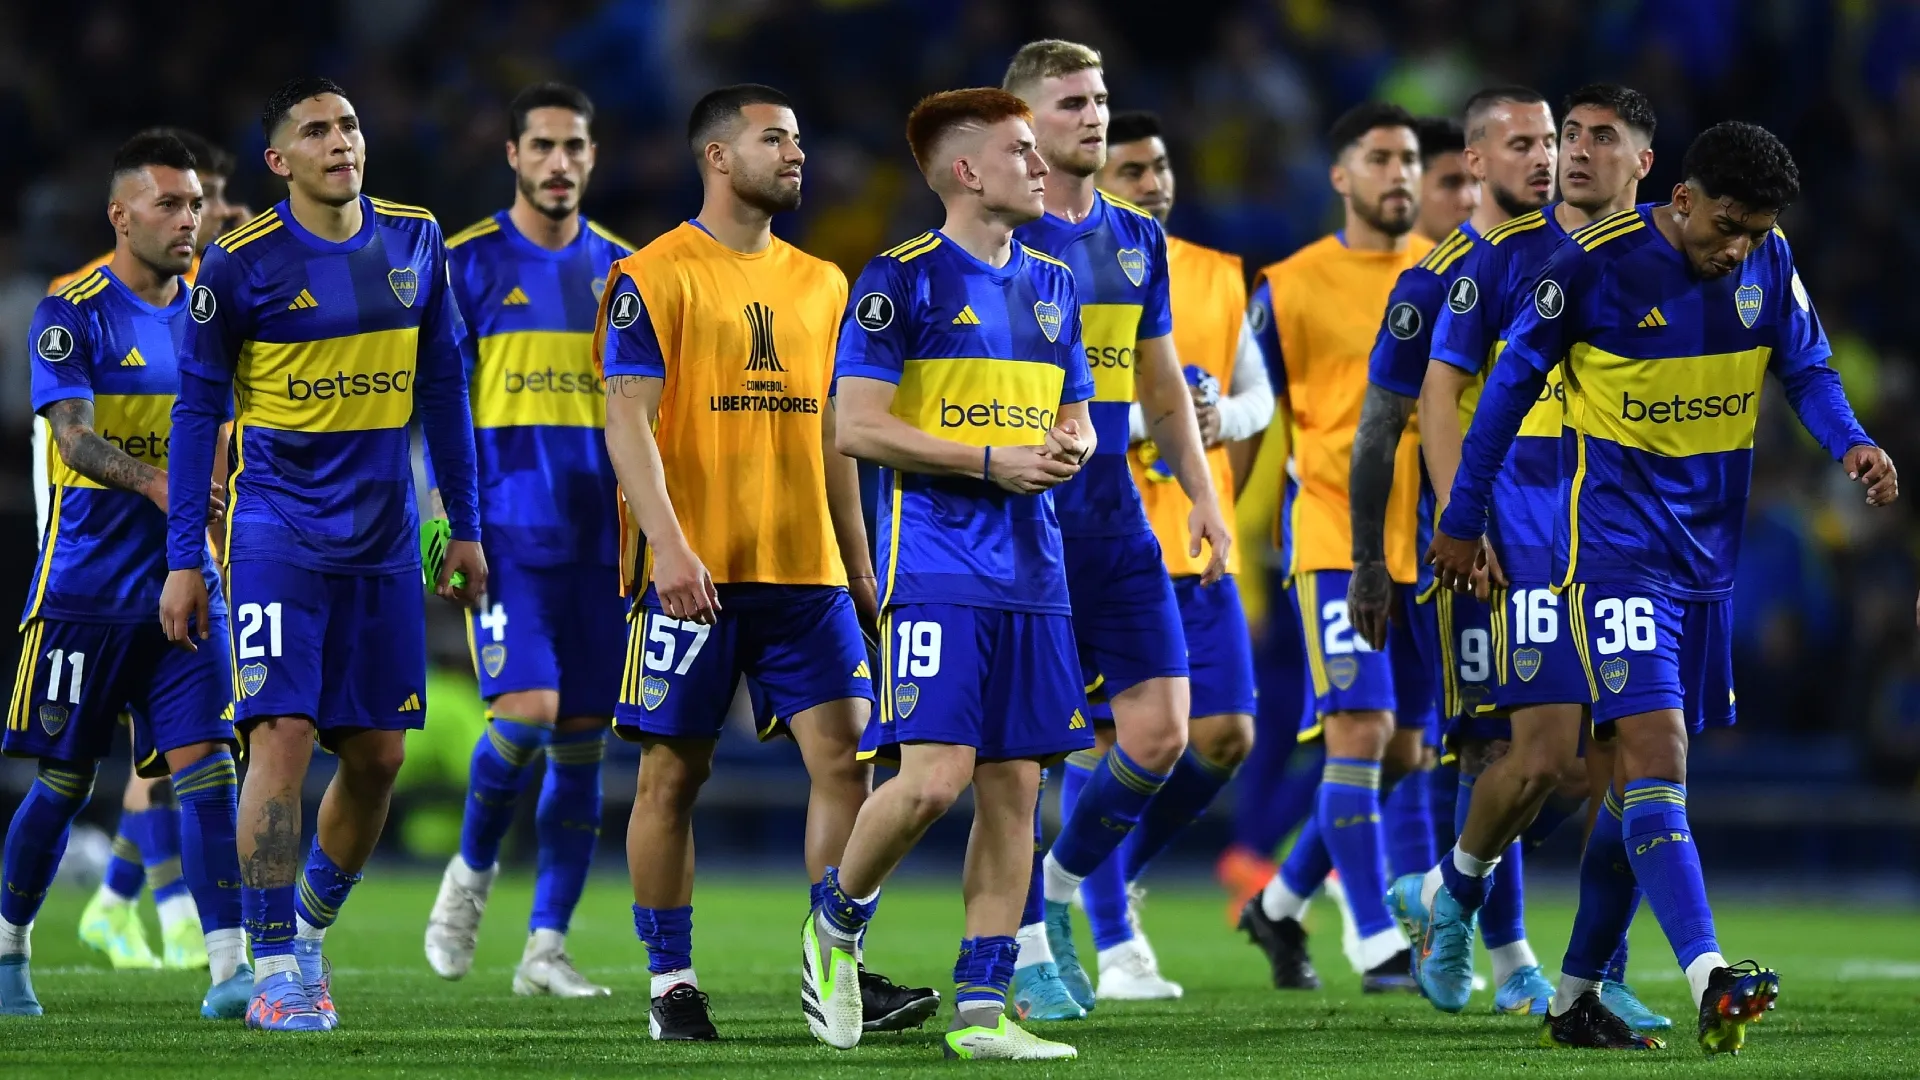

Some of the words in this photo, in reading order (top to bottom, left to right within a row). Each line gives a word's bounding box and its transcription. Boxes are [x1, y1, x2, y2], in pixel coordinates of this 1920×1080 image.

[1039, 314, 1059, 325] CABJ
[1739, 299, 1759, 309] CABJ
[710, 395, 819, 415] LIBERTADORES
[238, 602, 282, 660] 21
[480, 593, 509, 642] 4
[1321, 599, 1374, 654] 2
[1511, 588, 1558, 645] 16
[1594, 596, 1657, 655] 36
[645, 613, 711, 676] 57
[897, 620, 942, 678] 19
[1460, 628, 1490, 682] 9
[46, 648, 85, 705] 11
[243, 673, 263, 683] CABJ
[644, 686, 664, 697] CABJ
[1604, 668, 1626, 680] CABJ
